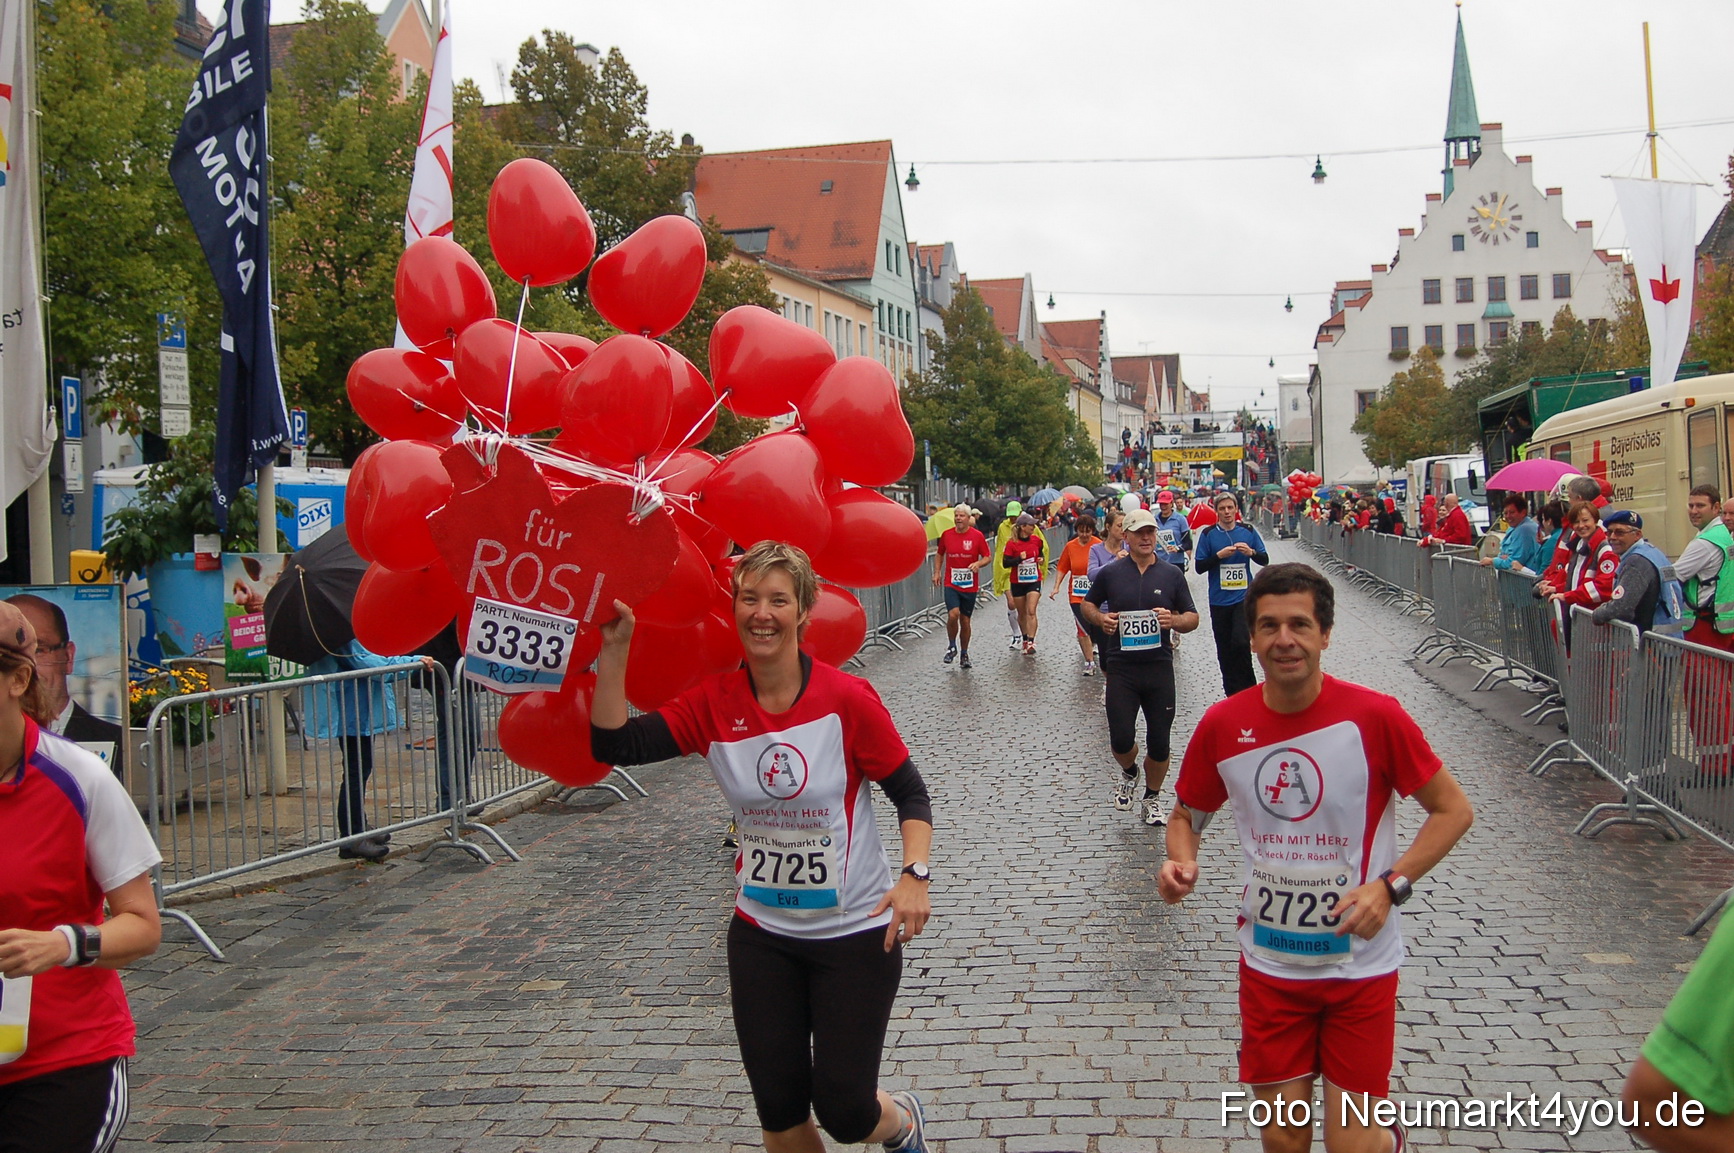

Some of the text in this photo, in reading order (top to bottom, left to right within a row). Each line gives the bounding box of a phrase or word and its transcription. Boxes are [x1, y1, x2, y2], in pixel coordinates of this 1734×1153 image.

[66, 386, 77, 431] P
[295, 415, 304, 442] P
[1610, 429, 1661, 458] Bayerisches
[1181, 451, 1212, 459] START
[1610, 459, 1635, 479] Rotes
[1611, 483, 1634, 502] Kreuz
[525, 508, 572, 550] für
[466, 538, 606, 623] ROSI
[953, 573, 972, 581] 2378
[1020, 567, 1036, 576] 2282
[1226, 570, 1244, 580] 266
[475, 602, 560, 631] PARTL Neumarkt
[233, 626, 256, 637] BEIDE
[1123, 619, 1158, 636] 2568
[477, 620, 565, 670] 3333
[487, 661, 541, 684] ROSI
[741, 807, 830, 819] LAUFEN MIT HERZ
[743, 833, 816, 849] PARTL Neumarkt
[1288, 834, 1311, 846] MIT
[1315, 833, 1350, 847] HERZ
[1291, 851, 1305, 861] Dr.
[1307, 850, 1339, 861] Röschl
[751, 849, 828, 885] 2725
[1252, 868, 1332, 888] PARTL Neumarkt
[777, 892, 800, 907] Eva
[1258, 886, 1341, 928] 2723
[1267, 932, 1331, 953] Johannes
